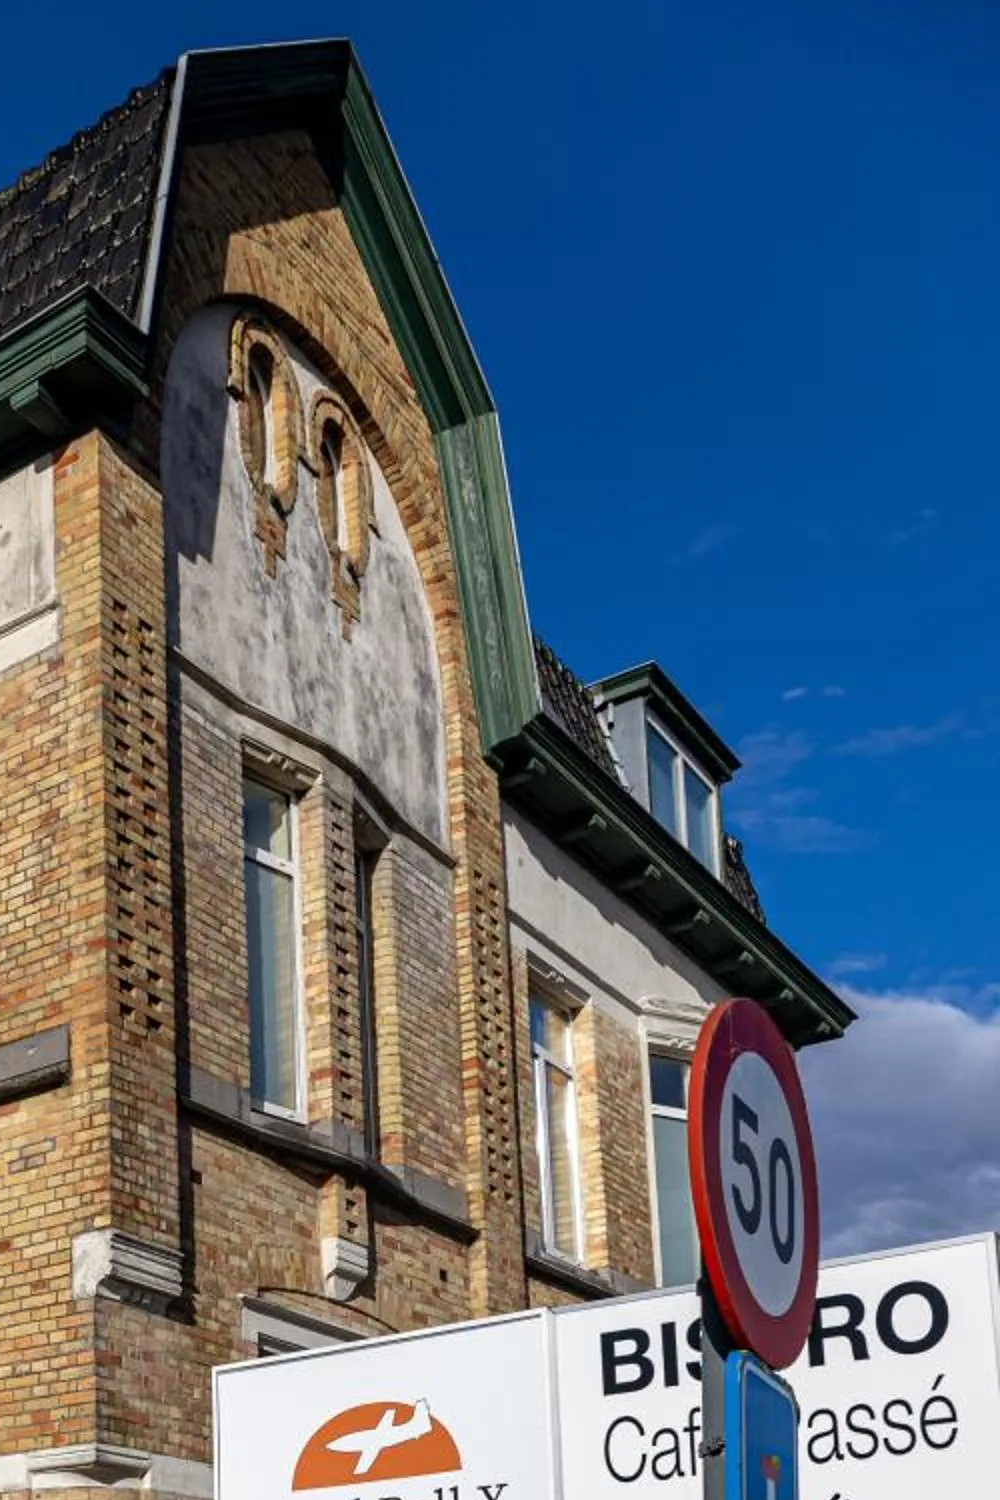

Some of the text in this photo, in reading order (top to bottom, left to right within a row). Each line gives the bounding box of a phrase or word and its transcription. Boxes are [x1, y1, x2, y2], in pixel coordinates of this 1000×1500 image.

[731, 1094, 796, 1265] 50
[600, 1280, 950, 1395] BIRO
[604, 1374, 959, 1483] Caf assé
